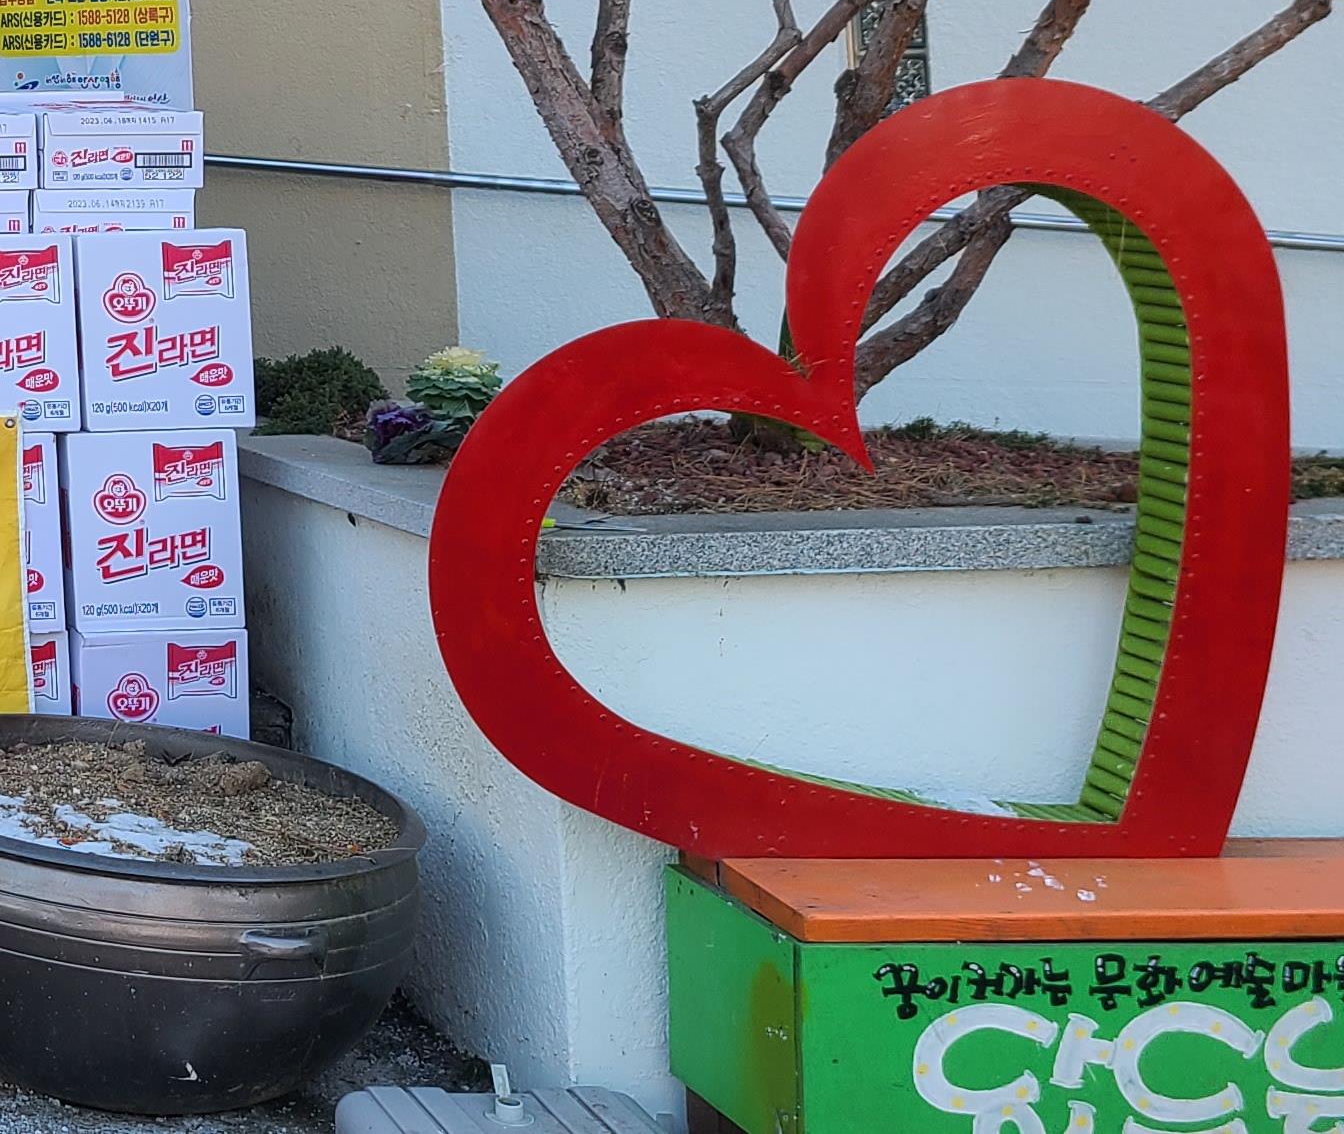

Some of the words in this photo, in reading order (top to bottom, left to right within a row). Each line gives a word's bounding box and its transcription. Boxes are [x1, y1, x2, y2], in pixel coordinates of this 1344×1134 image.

[1, 10, 67, 28] ARS(신용카드)
[77, 8, 130, 26] 1588-5128
[2, 33, 68, 50] ARS(신용카드)
[79, 31, 131, 48] 1588-6128
[135, 30, 175, 48] (단원구)
[0, 264, 49, 288] 진라면
[174, 261, 221, 285] 진라면
[112, 296, 147, 313] 오뚜기
[106, 325, 220, 383] 진라면
[24, 372, 55, 390] 매운맛
[199, 366, 229, 384] 매운맛
[165, 460, 212, 481] 진라면
[102, 497, 138, 513] 오뚜기
[96, 526, 211, 584] 진라면
[190, 569, 219, 587] 매운맛
[178, 660, 225, 683] 진라면
[116, 696, 150, 712] 오뚜기
